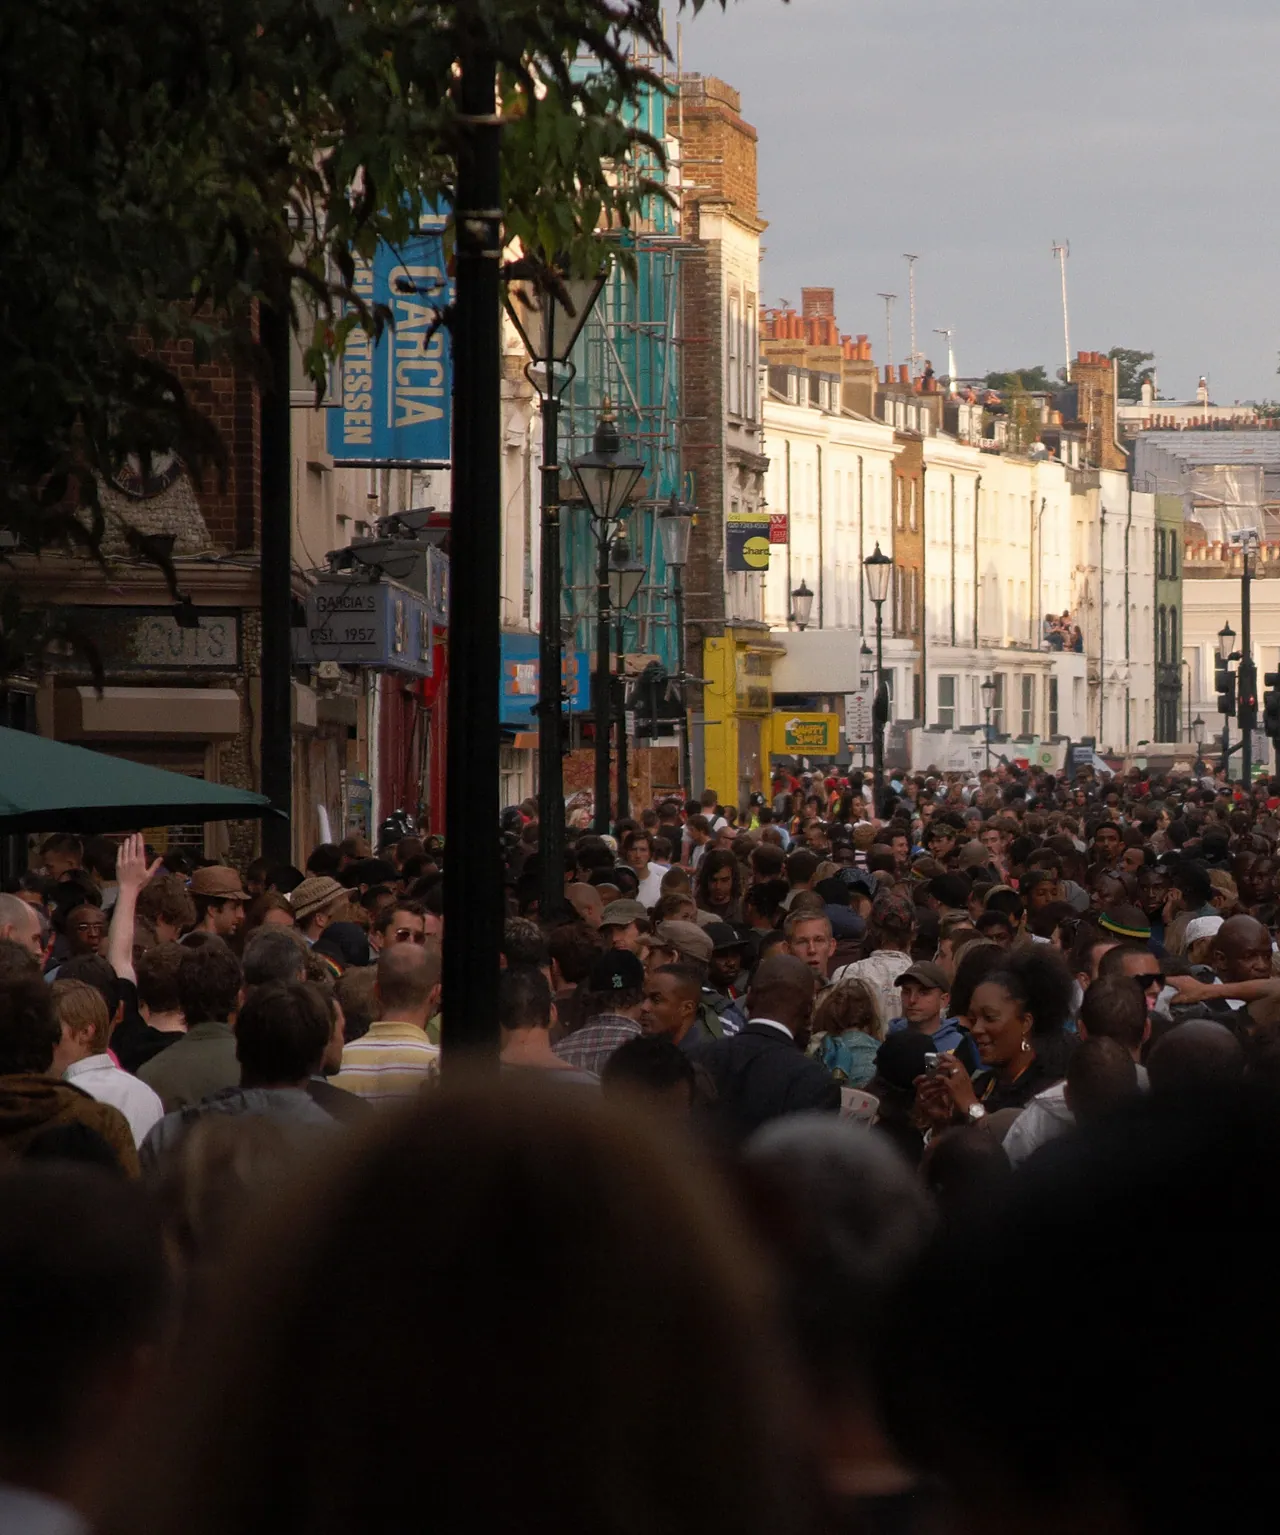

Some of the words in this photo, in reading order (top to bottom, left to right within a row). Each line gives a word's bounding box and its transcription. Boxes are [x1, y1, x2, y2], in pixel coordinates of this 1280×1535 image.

[388, 265, 445, 428] GARCIA
[316, 596, 375, 612] GARCIA'S
[345, 628, 376, 640] 1957
